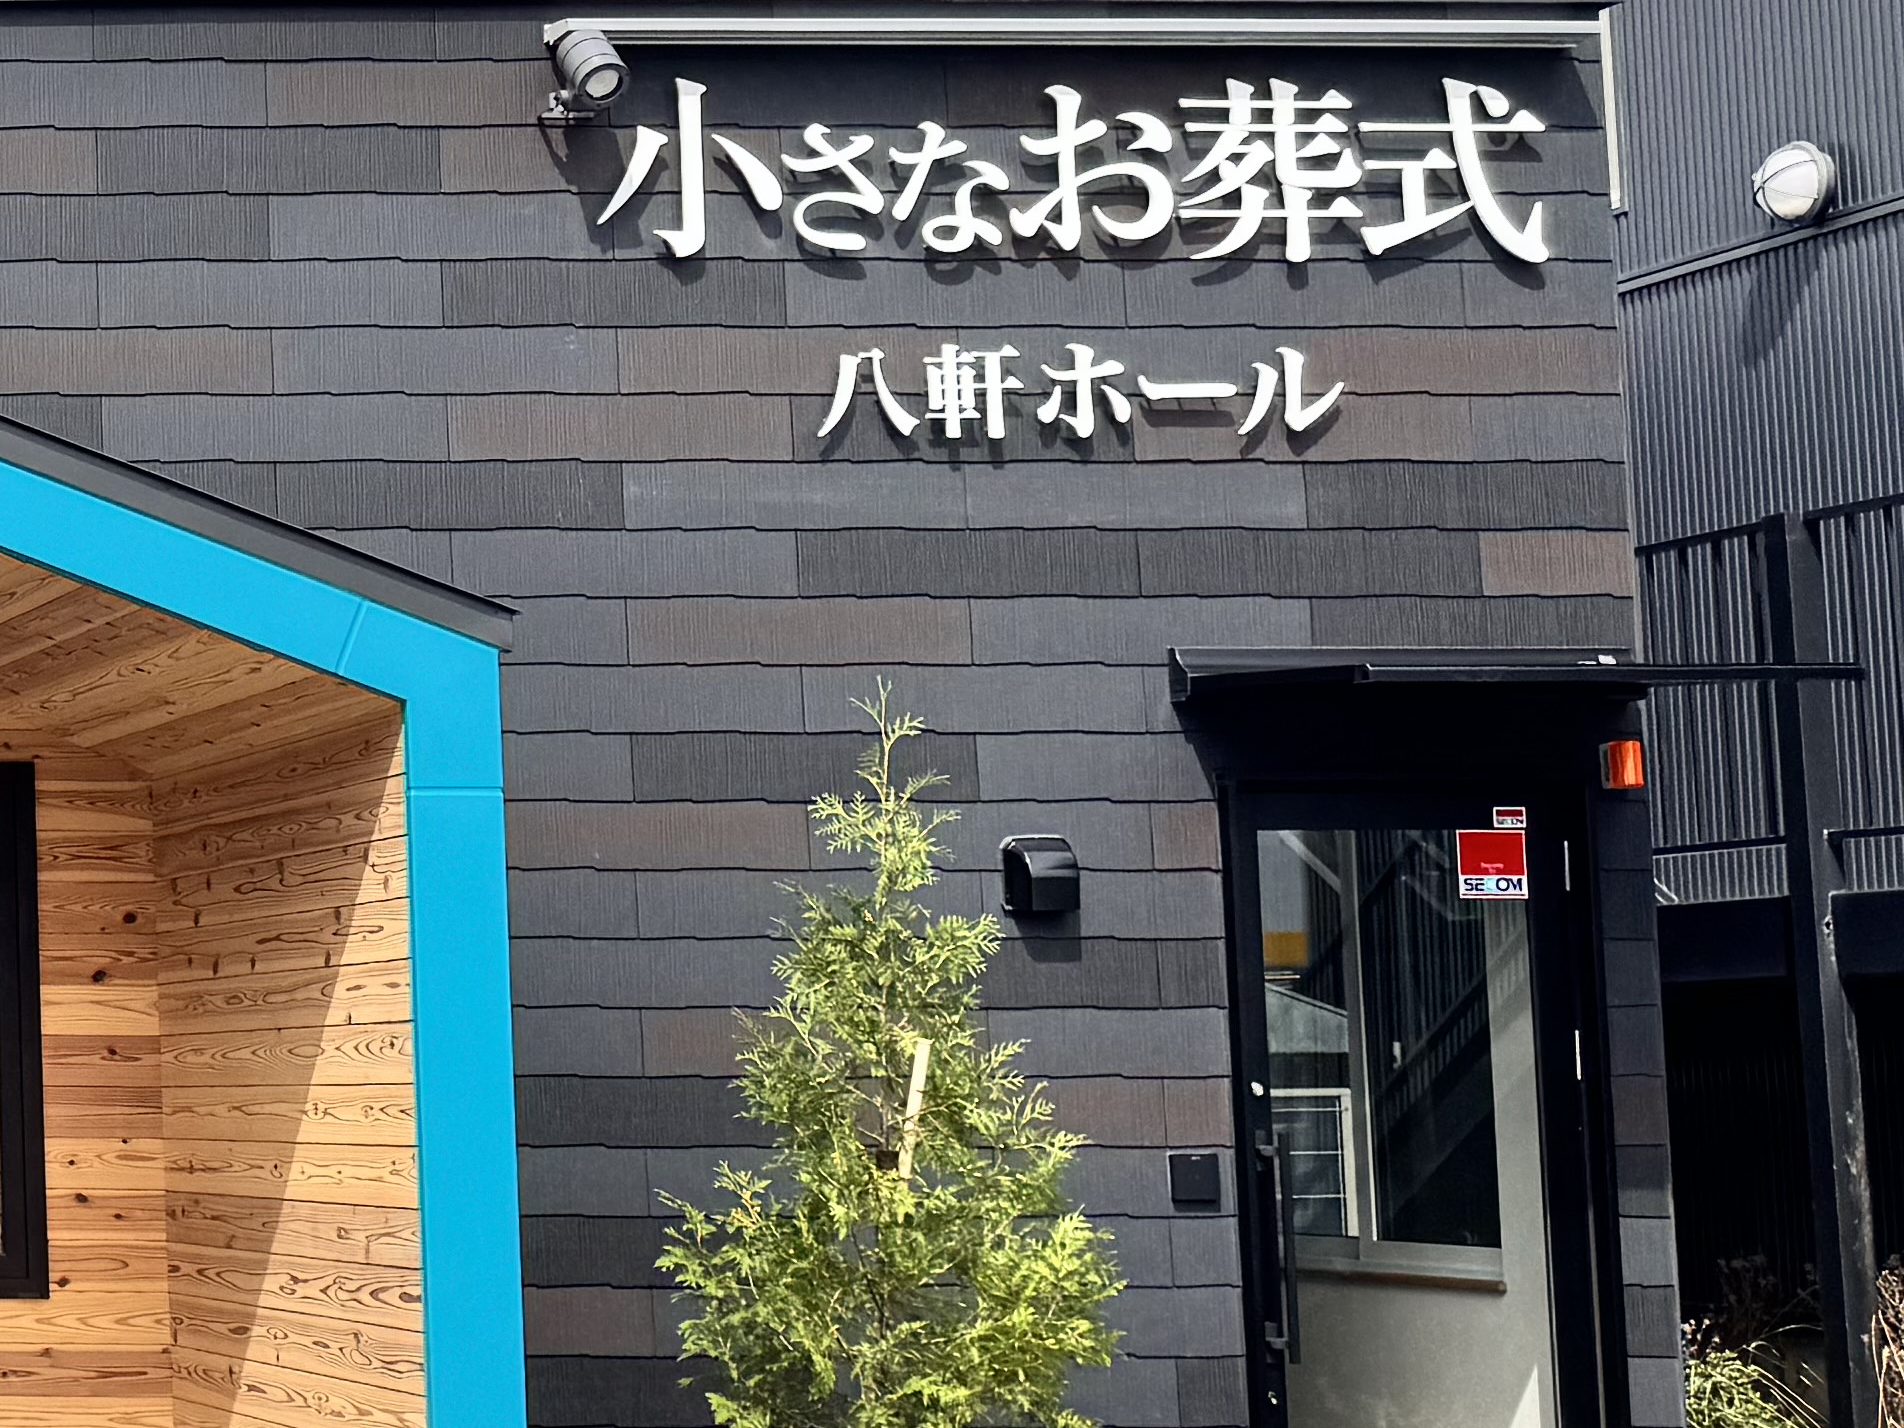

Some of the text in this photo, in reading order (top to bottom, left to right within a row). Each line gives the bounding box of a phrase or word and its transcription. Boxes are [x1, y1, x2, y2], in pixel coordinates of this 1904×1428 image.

[596, 77, 1551, 264] 小さなお葬式
[816, 342, 1346, 440] 八軒ホール
[1463, 877, 1523, 892] SECOM
